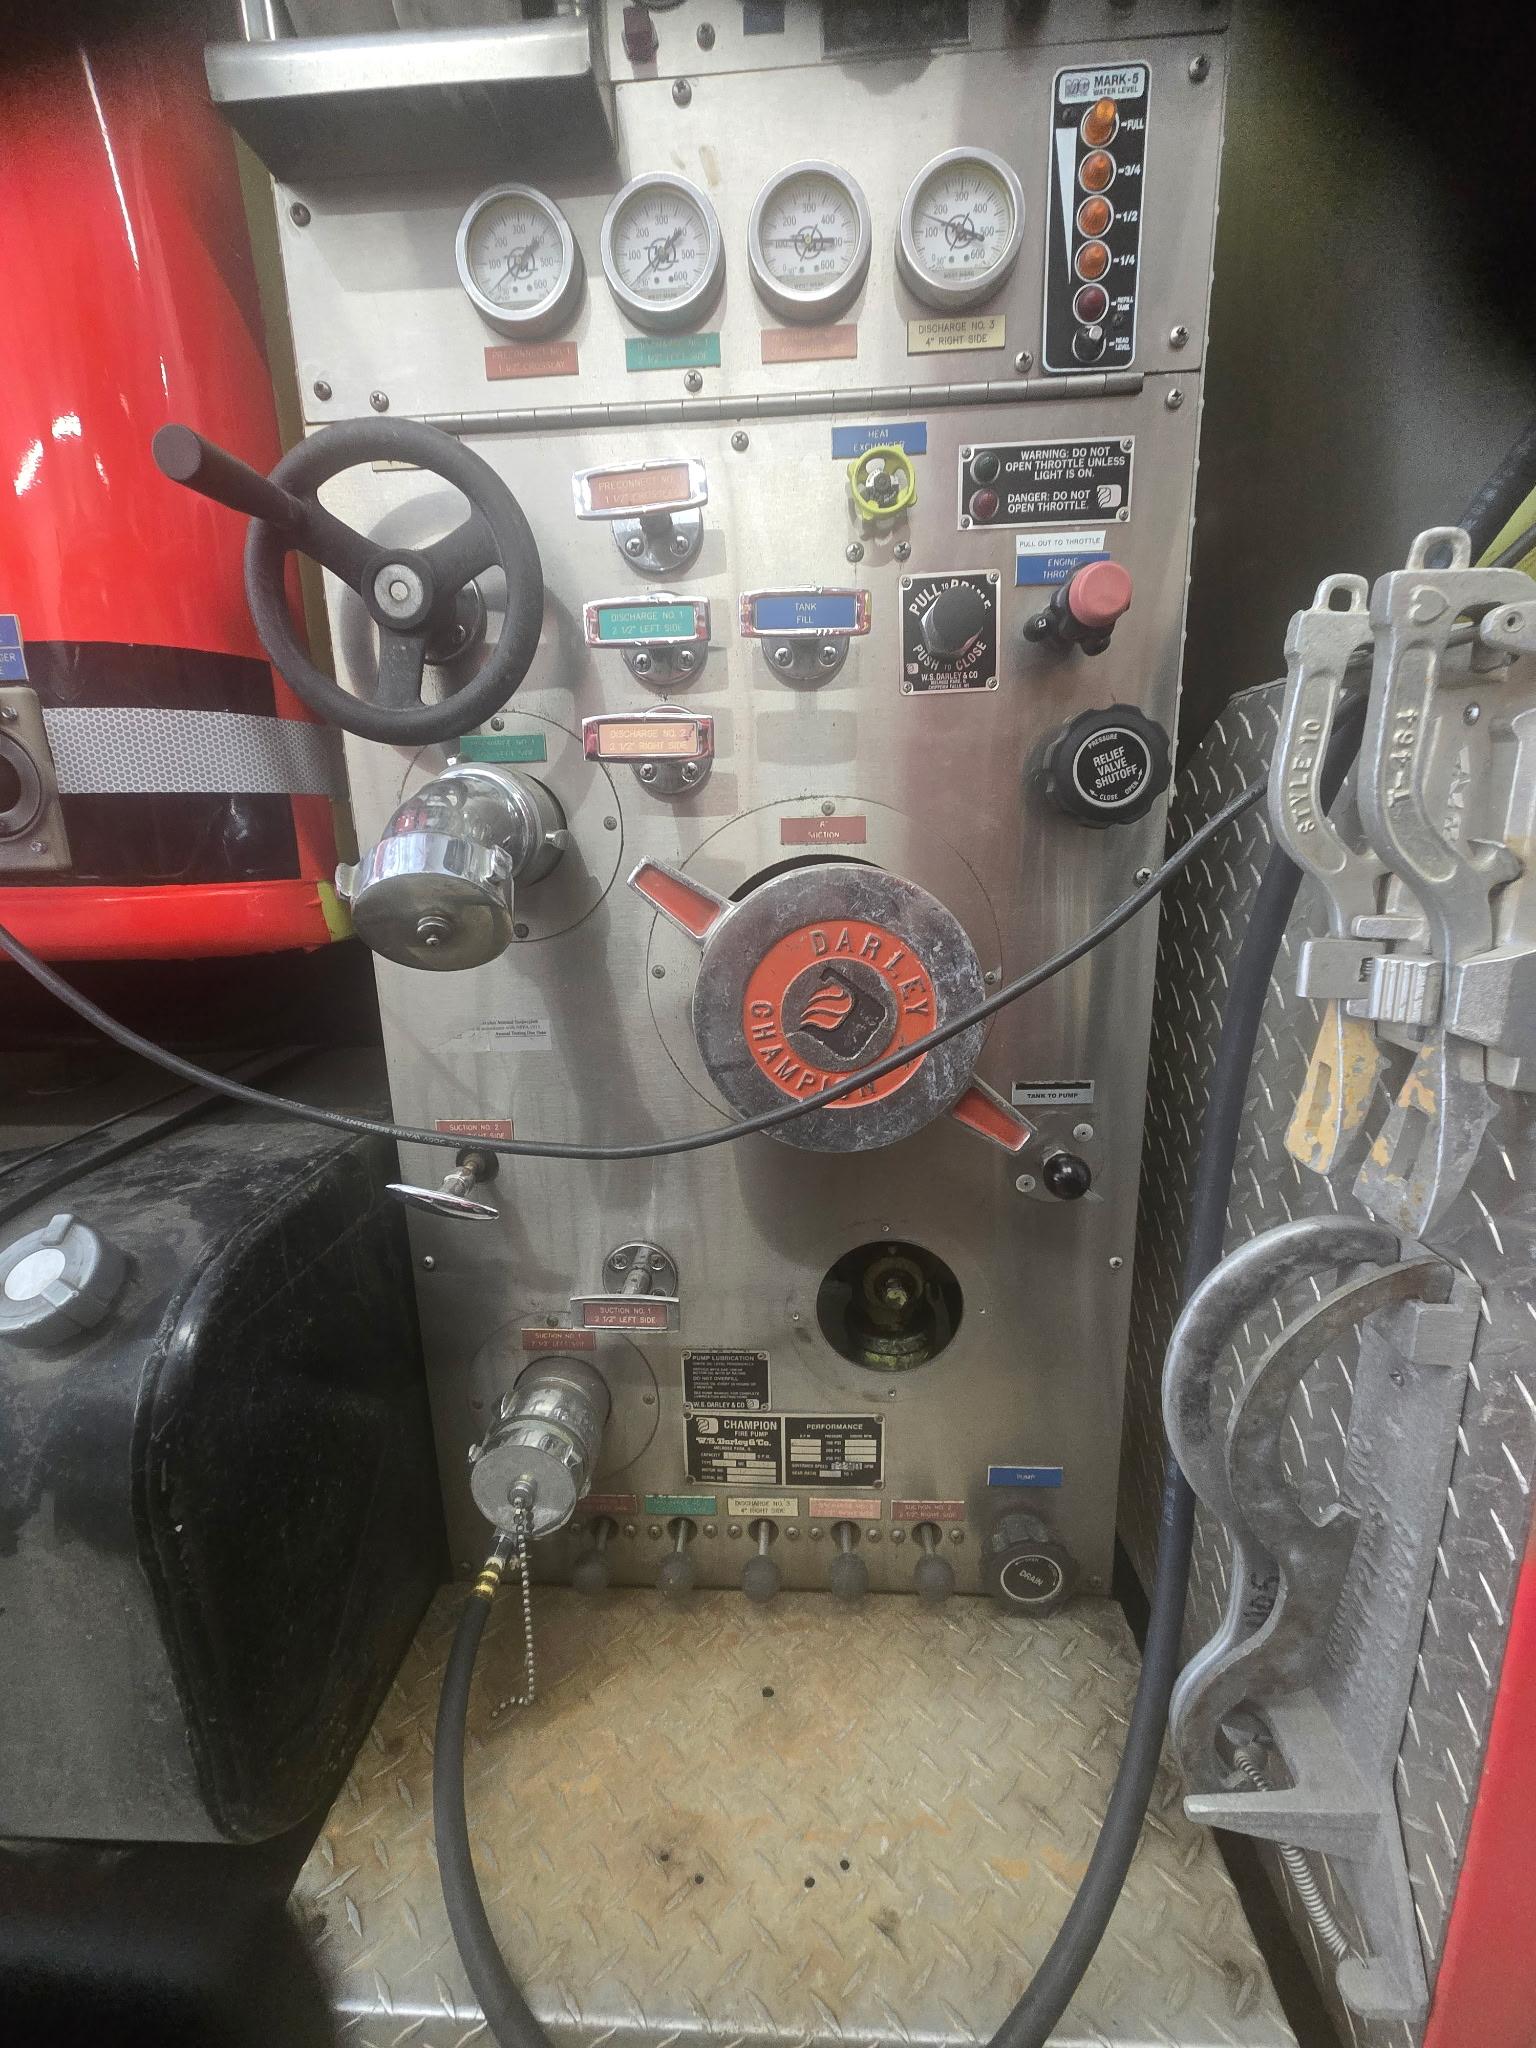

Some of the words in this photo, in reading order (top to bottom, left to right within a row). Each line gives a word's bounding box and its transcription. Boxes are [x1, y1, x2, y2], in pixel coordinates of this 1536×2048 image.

[1093, 88, 1116, 96] WATER
[1118, 86, 1138, 94] LEVEL
[1127, 119, 1144, 131] FULL
[1124, 164, 1141, 176] 3/4
[955, 191, 969, 202] 300
[802, 203, 816, 213] 300
[934, 204, 948, 215] 200
[972, 203, 988, 213] 400
[654, 215, 668, 225] 300
[783, 215, 797, 226] 200
[821, 214, 835, 224] 400
[1122, 211, 1138, 222] 1/2
[636, 227, 649, 238] 200
[924, 227, 938, 238] 100
[980, 226, 994, 237] 500
[628, 250, 641, 260] 100
[681, 250, 695, 260] 500
[970, 249, 985, 259] 600
[1120, 254, 1136, 265] 1/4
[488, 259, 501, 270] 100
[820, 259, 834, 270] 600
[674, 271, 688, 281] 600
[918, 321, 967, 335] DISCHARGE
[989, 319, 995, 329] 3
[925, 337, 935, 346] 4"
[938, 335, 964, 346] RIGHT
[968, 333, 988, 344] SIDE
[868, 428, 889, 438] HEAT
[1020, 449, 1069, 461] WARNING:
[1072, 448, 1087, 458] DO
[1090, 446, 1111, 457] NOT
[1005, 460, 1032, 472] OPEN
[1035, 457, 1085, 470] THROTTLE
[1087, 456, 1126, 467] UNLESS
[1034, 470, 1063, 481] LIGHT
[1065, 469, 1075, 479] IS
[1077, 468, 1095, 478] ON.
[1007, 492, 1050, 503] DANGER:
[1052, 490, 1068, 501] DO
[1070, 489, 1091, 500] NOT
[1007, 503, 1034, 514] OPEN
[1037, 500, 1089, 513] THROTTLE.
[1019, 540, 1036, 548] PULL
[1066, 537, 1101, 545] THROTTLE
[1047, 557, 1078, 567] ENGINE
[908, 583, 942, 617] PULL
[795, 602, 817, 611] TANK
[610, 611, 657, 622] DISCHARGE
[796, 615, 813, 624] FILL
[611, 626, 617, 635] 2
[640, 624, 660, 634] LEFT
[664, 623, 682, 632] SIDE
[912, 643, 940, 671] PUSH
[955, 640, 987, 671] CLOSE
[936, 672, 962, 680] DARLEY
[963, 671, 967, 679] &
[610, 728, 658, 738] DISCHARGE
[679, 728, 687, 738] 2
[1294, 718, 1321, 745] 10
[1088, 733, 1118, 749] PRESSURE
[1093, 746, 1125, 768] RELIEF
[1096, 756, 1128, 777] VALVE
[1095, 764, 1138, 789] SHUTOFF
[1124, 781, 1139, 795] OPEN
[1288, 756, 1316, 833] STYLE
[807, 831, 840, 839] SUCTION
[808, 927, 929, 1016] DARLEY
[594, 1315, 600, 1323] 2
[602, 1315, 617, 1323] 1/2"
[639, 1316, 656, 1324] SIDE
[723, 1419, 777, 1431] CHAMPION
[717, 1437, 749, 1447] Darley
[756, 1438, 772, 1447] Co.
[1018, 1569, 1044, 1587] DRAIN
